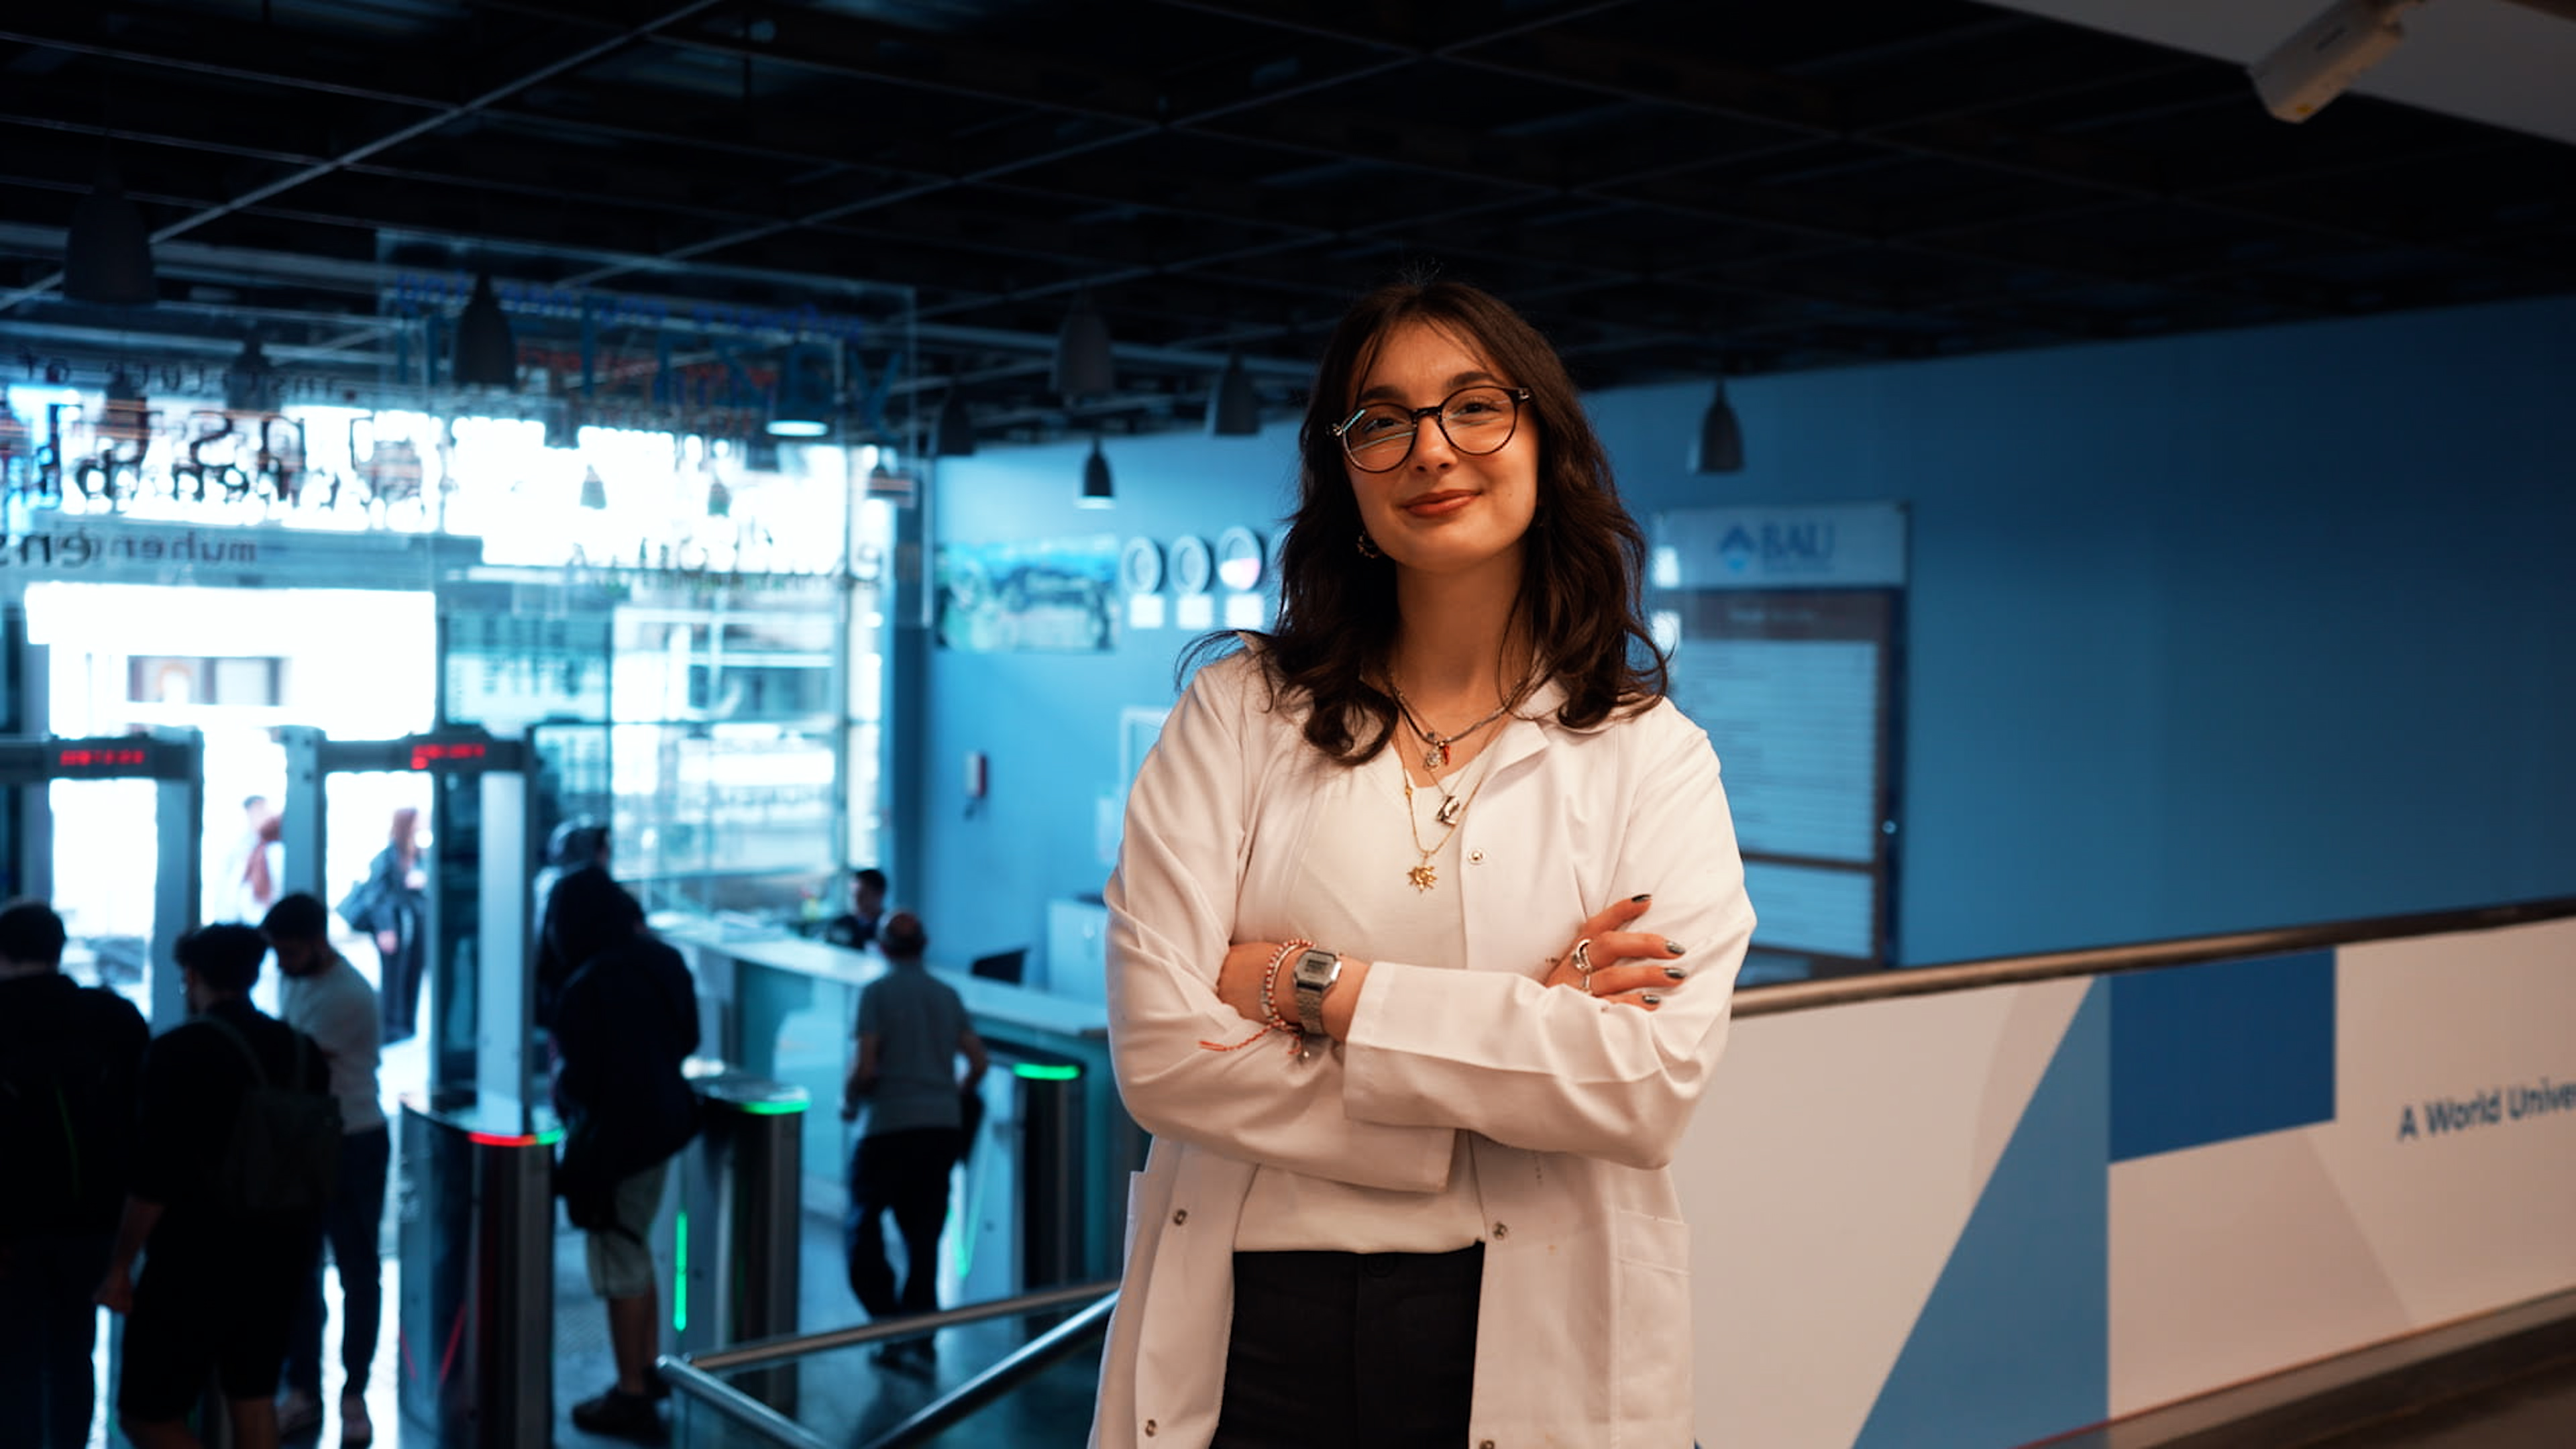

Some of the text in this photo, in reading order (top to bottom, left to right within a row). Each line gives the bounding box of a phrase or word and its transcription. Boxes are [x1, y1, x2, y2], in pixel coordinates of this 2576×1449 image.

[1760, 520, 1836, 559] BAU
[2398, 1104, 2420, 1142] A
[2424, 1087, 2502, 1136] World
